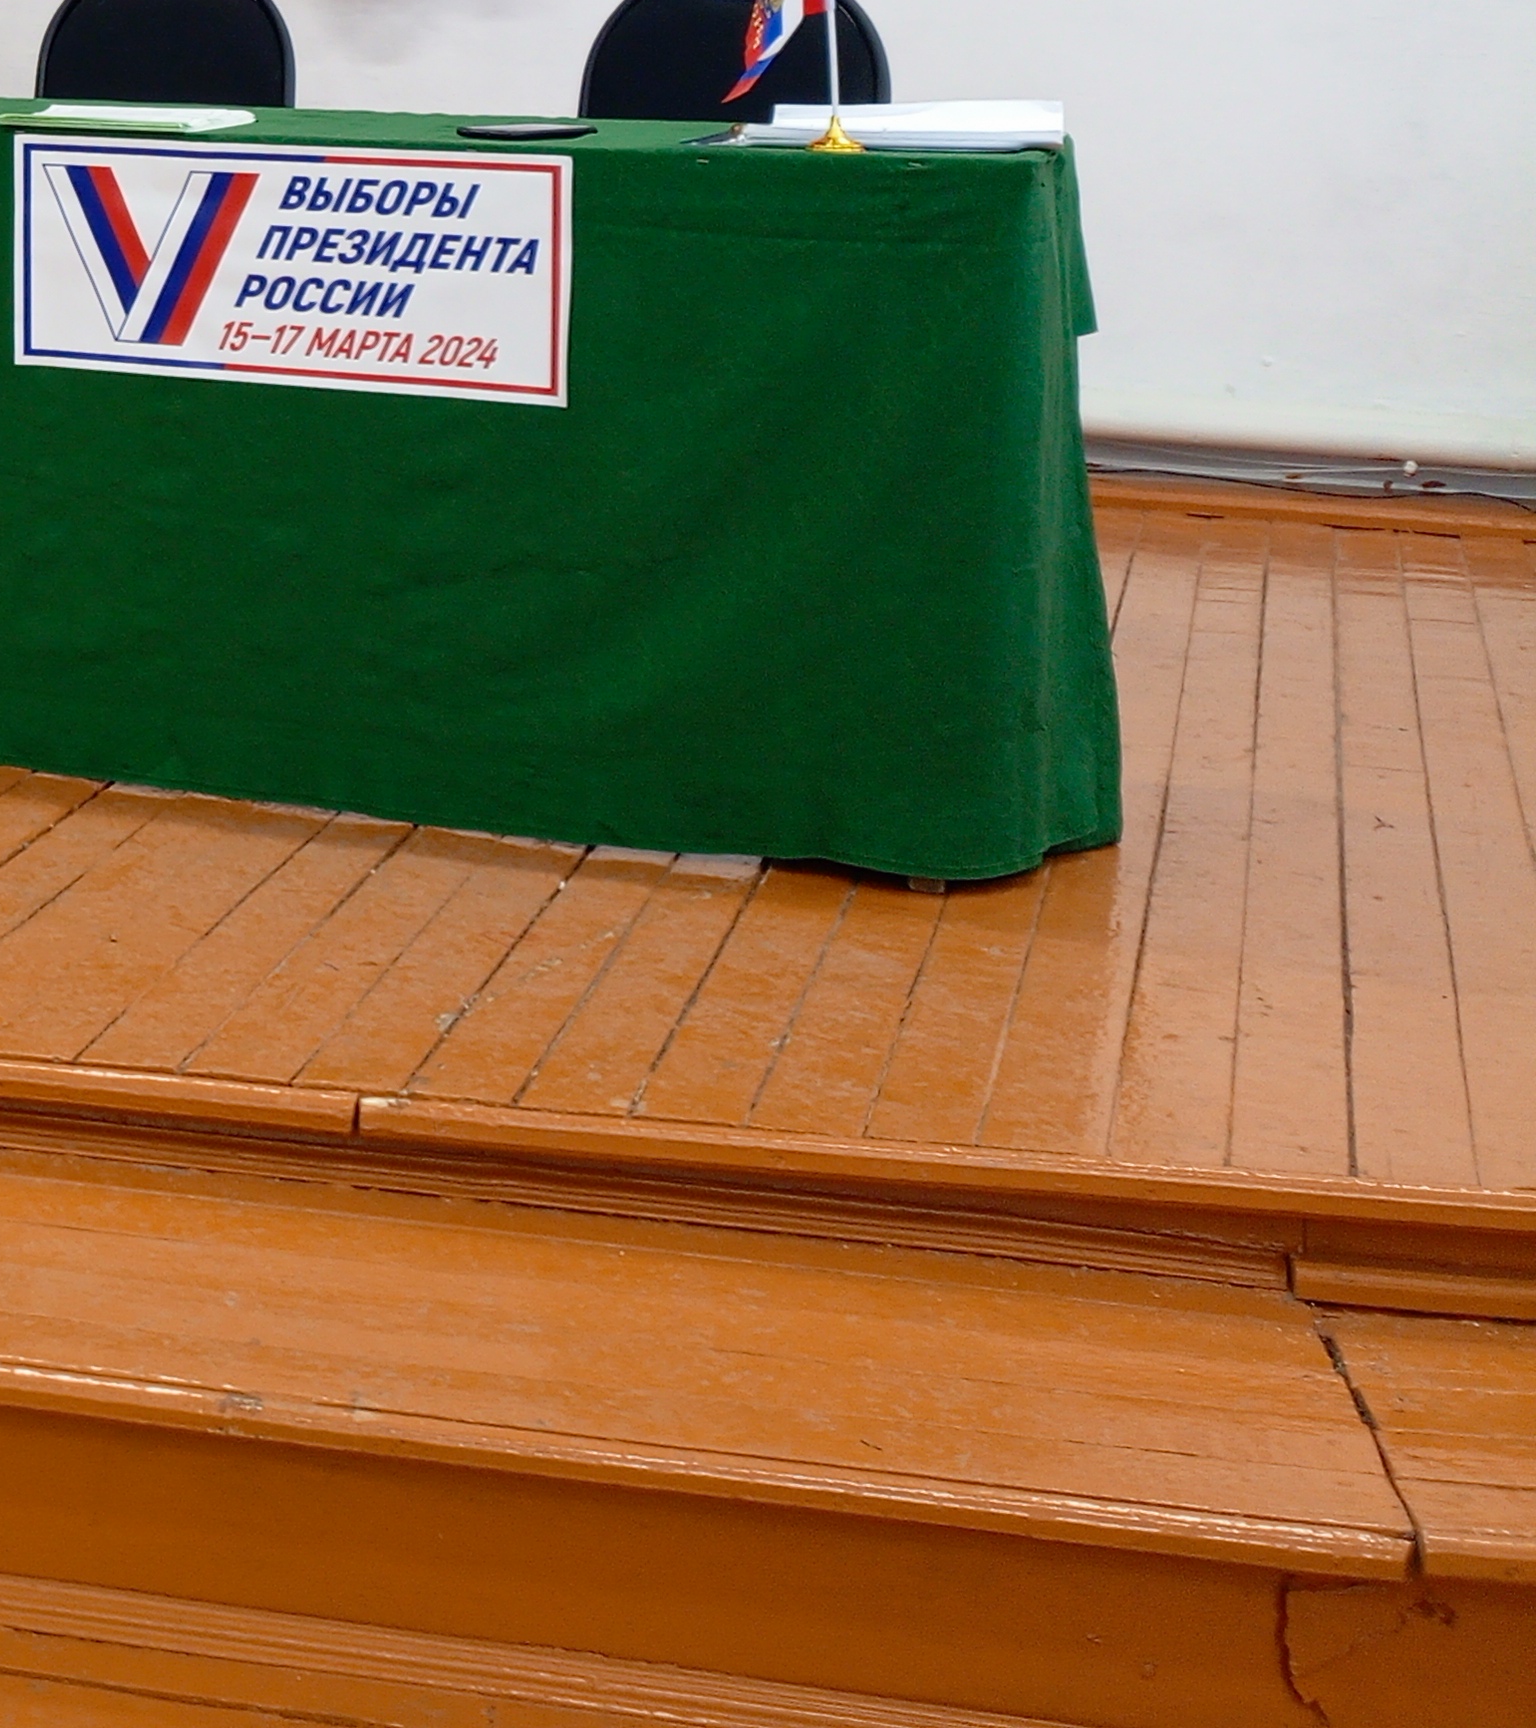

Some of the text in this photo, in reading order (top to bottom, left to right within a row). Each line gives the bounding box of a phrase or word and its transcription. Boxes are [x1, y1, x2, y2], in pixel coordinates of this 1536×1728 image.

[278, 175, 481, 219] ВЫБОРЫ
[256, 224, 540, 275] ПРЕЗИДЕНТА
[234, 273, 415, 319] РОССИИ
[305, 326, 414, 364] МАРТА
[417, 334, 499, 370] 2024
